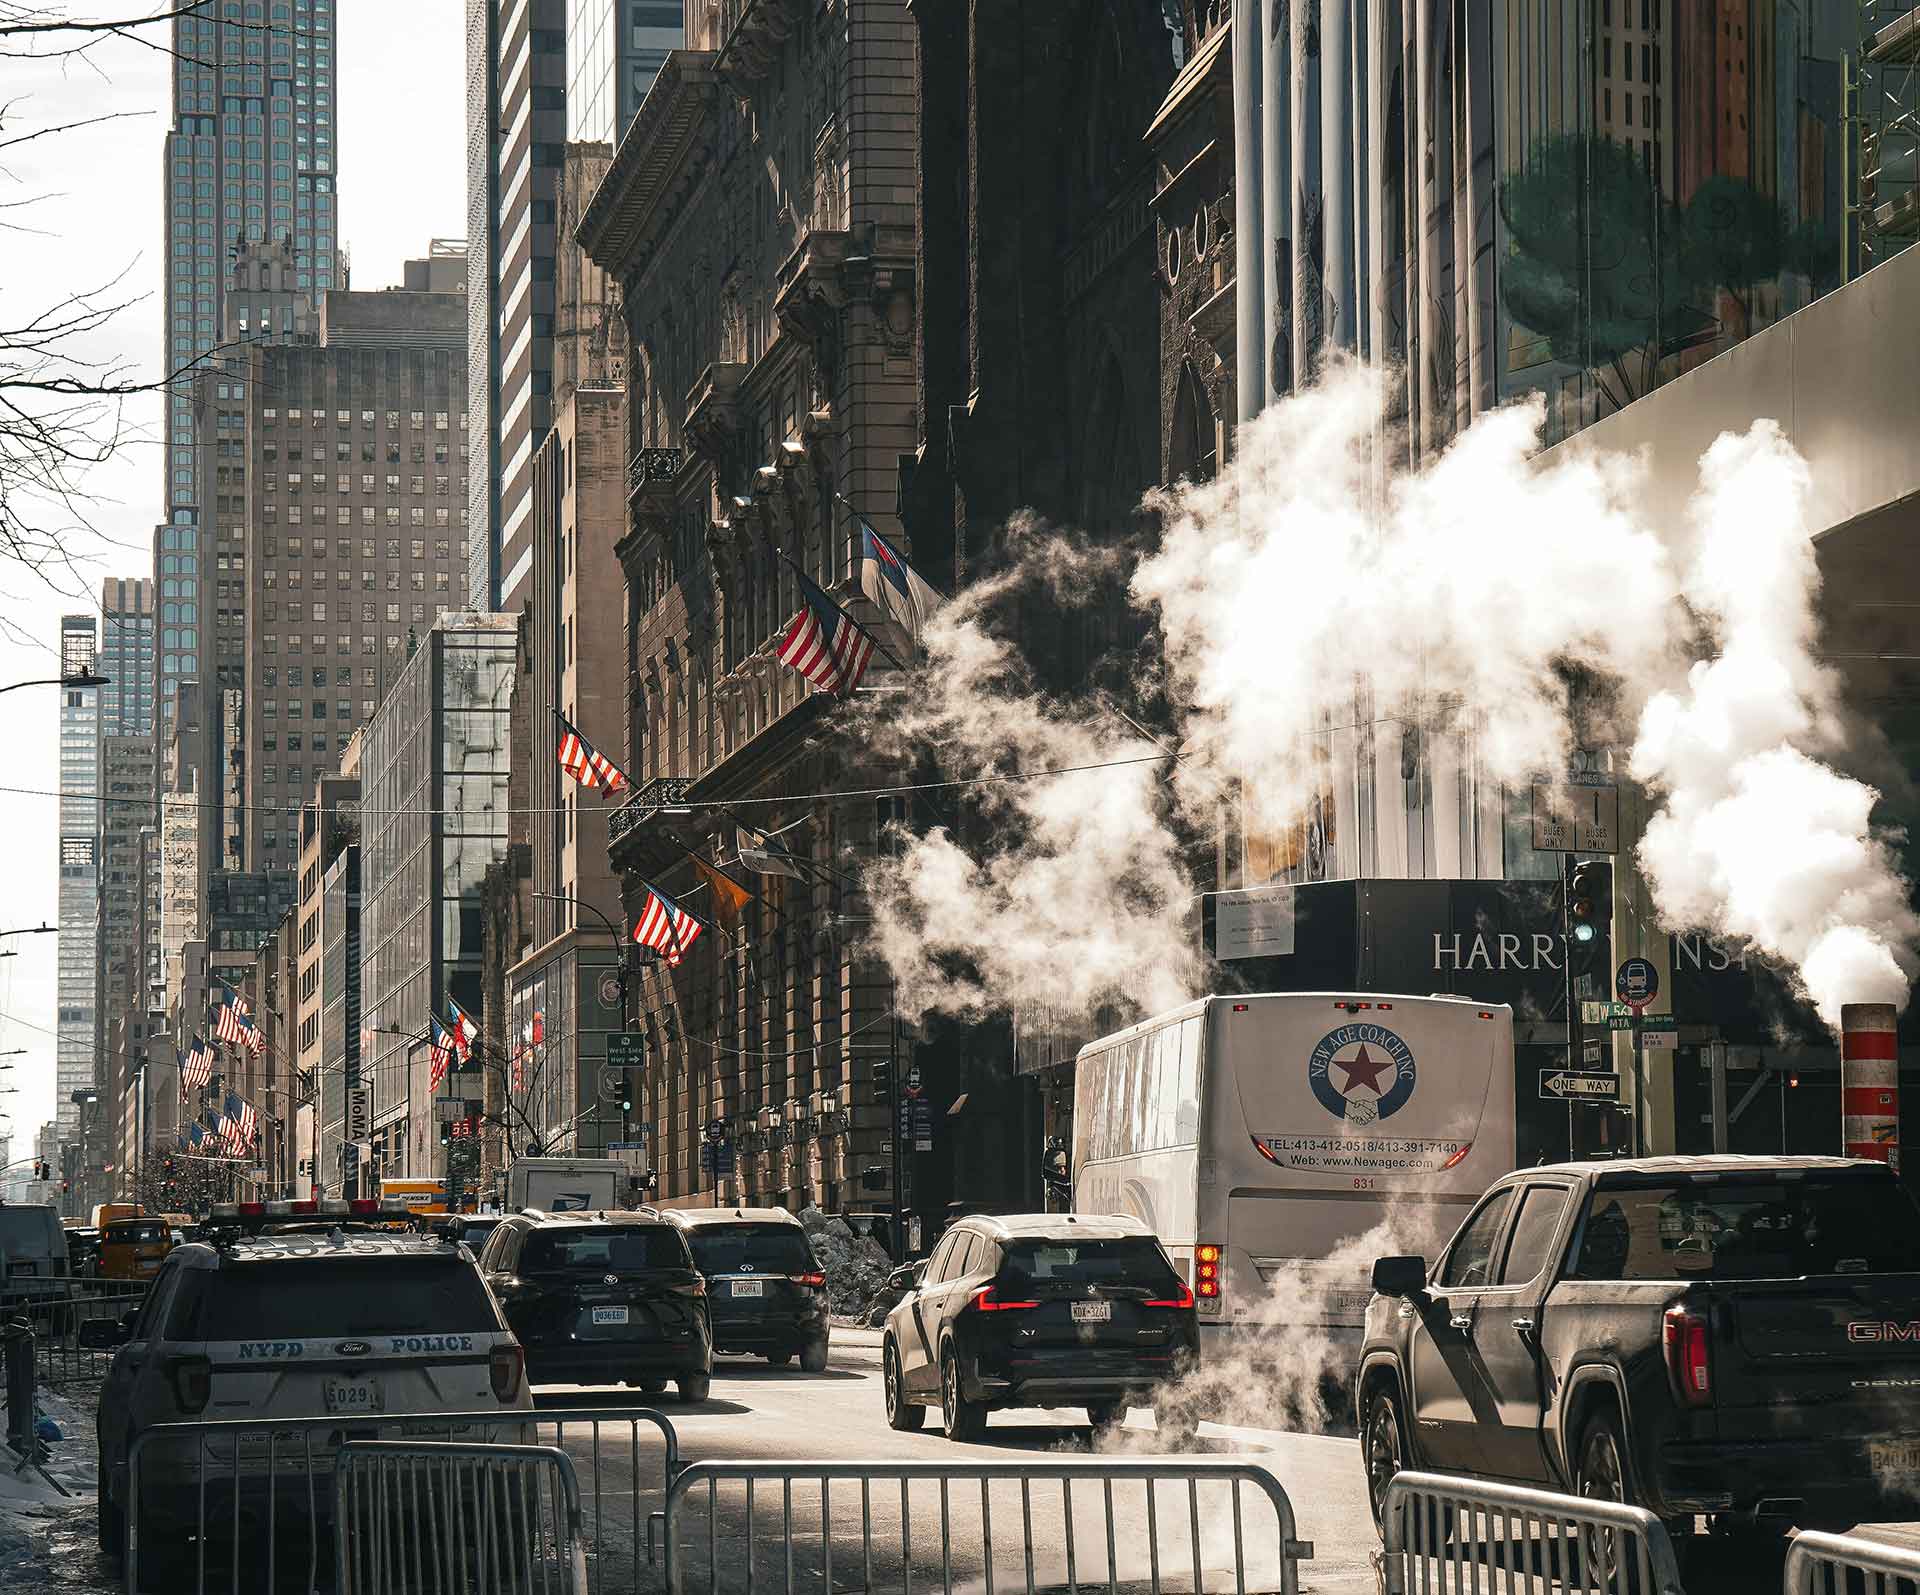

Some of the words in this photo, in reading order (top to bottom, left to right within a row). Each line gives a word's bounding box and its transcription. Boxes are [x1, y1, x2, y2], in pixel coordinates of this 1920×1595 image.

[1543, 826, 1565, 837] BUSES
[1586, 827, 1607, 838] BUSES
[1545, 838, 1564, 848] ONLY
[1587, 839, 1607, 849] ONLY
[1609, 1018, 1630, 1028] MTA
[1311, 1045, 1331, 1078] NEW
[1329, 1027, 1356, 1050] AGE
[1553, 1079, 1576, 1090] ONE
[1586, 1081, 1611, 1092] WAY
[352, 1091, 366, 1141] MoMA
[1290, 1155, 1319, 1166] Web:
[1324, 1156, 1433, 1169] www.Newagec.com
[1353, 1178, 1375, 1189] 831
[238, 1343, 304, 1358] NYPD
[343, 1344, 364, 1353] Ford
[391, 1337, 473, 1353] POLICE
[328, 1387, 368, 1403] 5029
